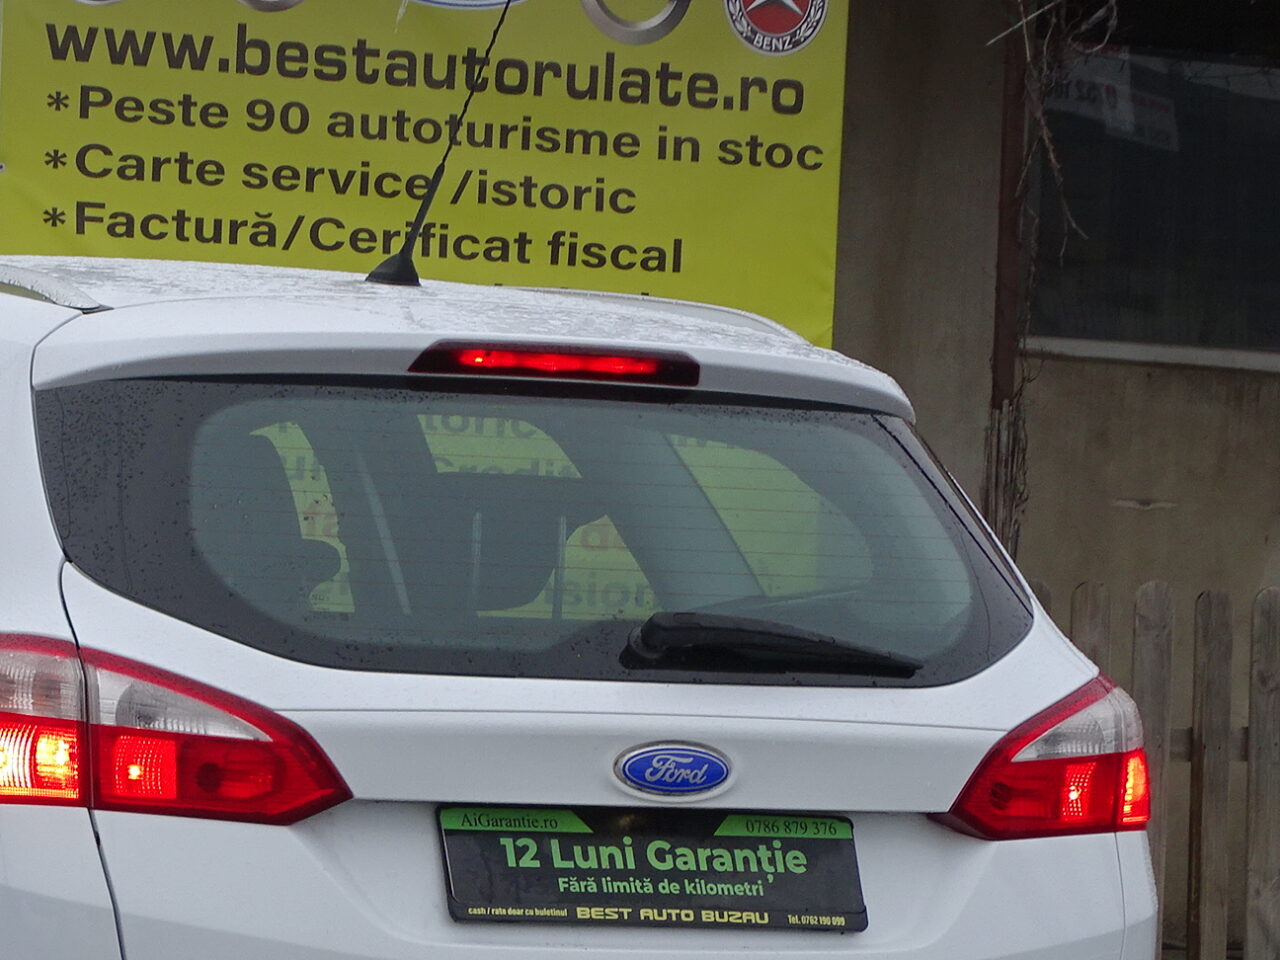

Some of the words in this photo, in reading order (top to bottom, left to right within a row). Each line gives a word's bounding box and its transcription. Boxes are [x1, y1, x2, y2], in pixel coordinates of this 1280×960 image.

[753, 33, 794, 51] BENZ
[45, 23, 805, 116] www.bestautorulate.ro
[245, 98, 310, 134] 90
[326, 109, 641, 158] autoturisme
[657, 125, 700, 162] in
[717, 135, 824, 171] stoc
[242, 161, 433, 200] service
[450, 169, 637, 214] /istoric
[547, 230, 683, 273] fiscal
[645, 755, 709, 784] Ford
[460, 813, 559, 830] AiGarantie.ro
[746, 819, 780, 834] 0786
[784, 820, 808, 835] 879
[812, 821, 838, 836] 376
[500, 837, 541, 868] 12
[550, 836, 636, 870] Luni
[646, 840, 808, 883] Garanție
[558, 876, 598, 893] Fără
[602, 876, 654, 894] limită
[658, 879, 681, 895] de
[684, 879, 765, 897] kilometri
[576, 906, 632, 920] BEST
[639, 908, 694, 922] AUTO
[701, 910, 769, 924] BUZAU
